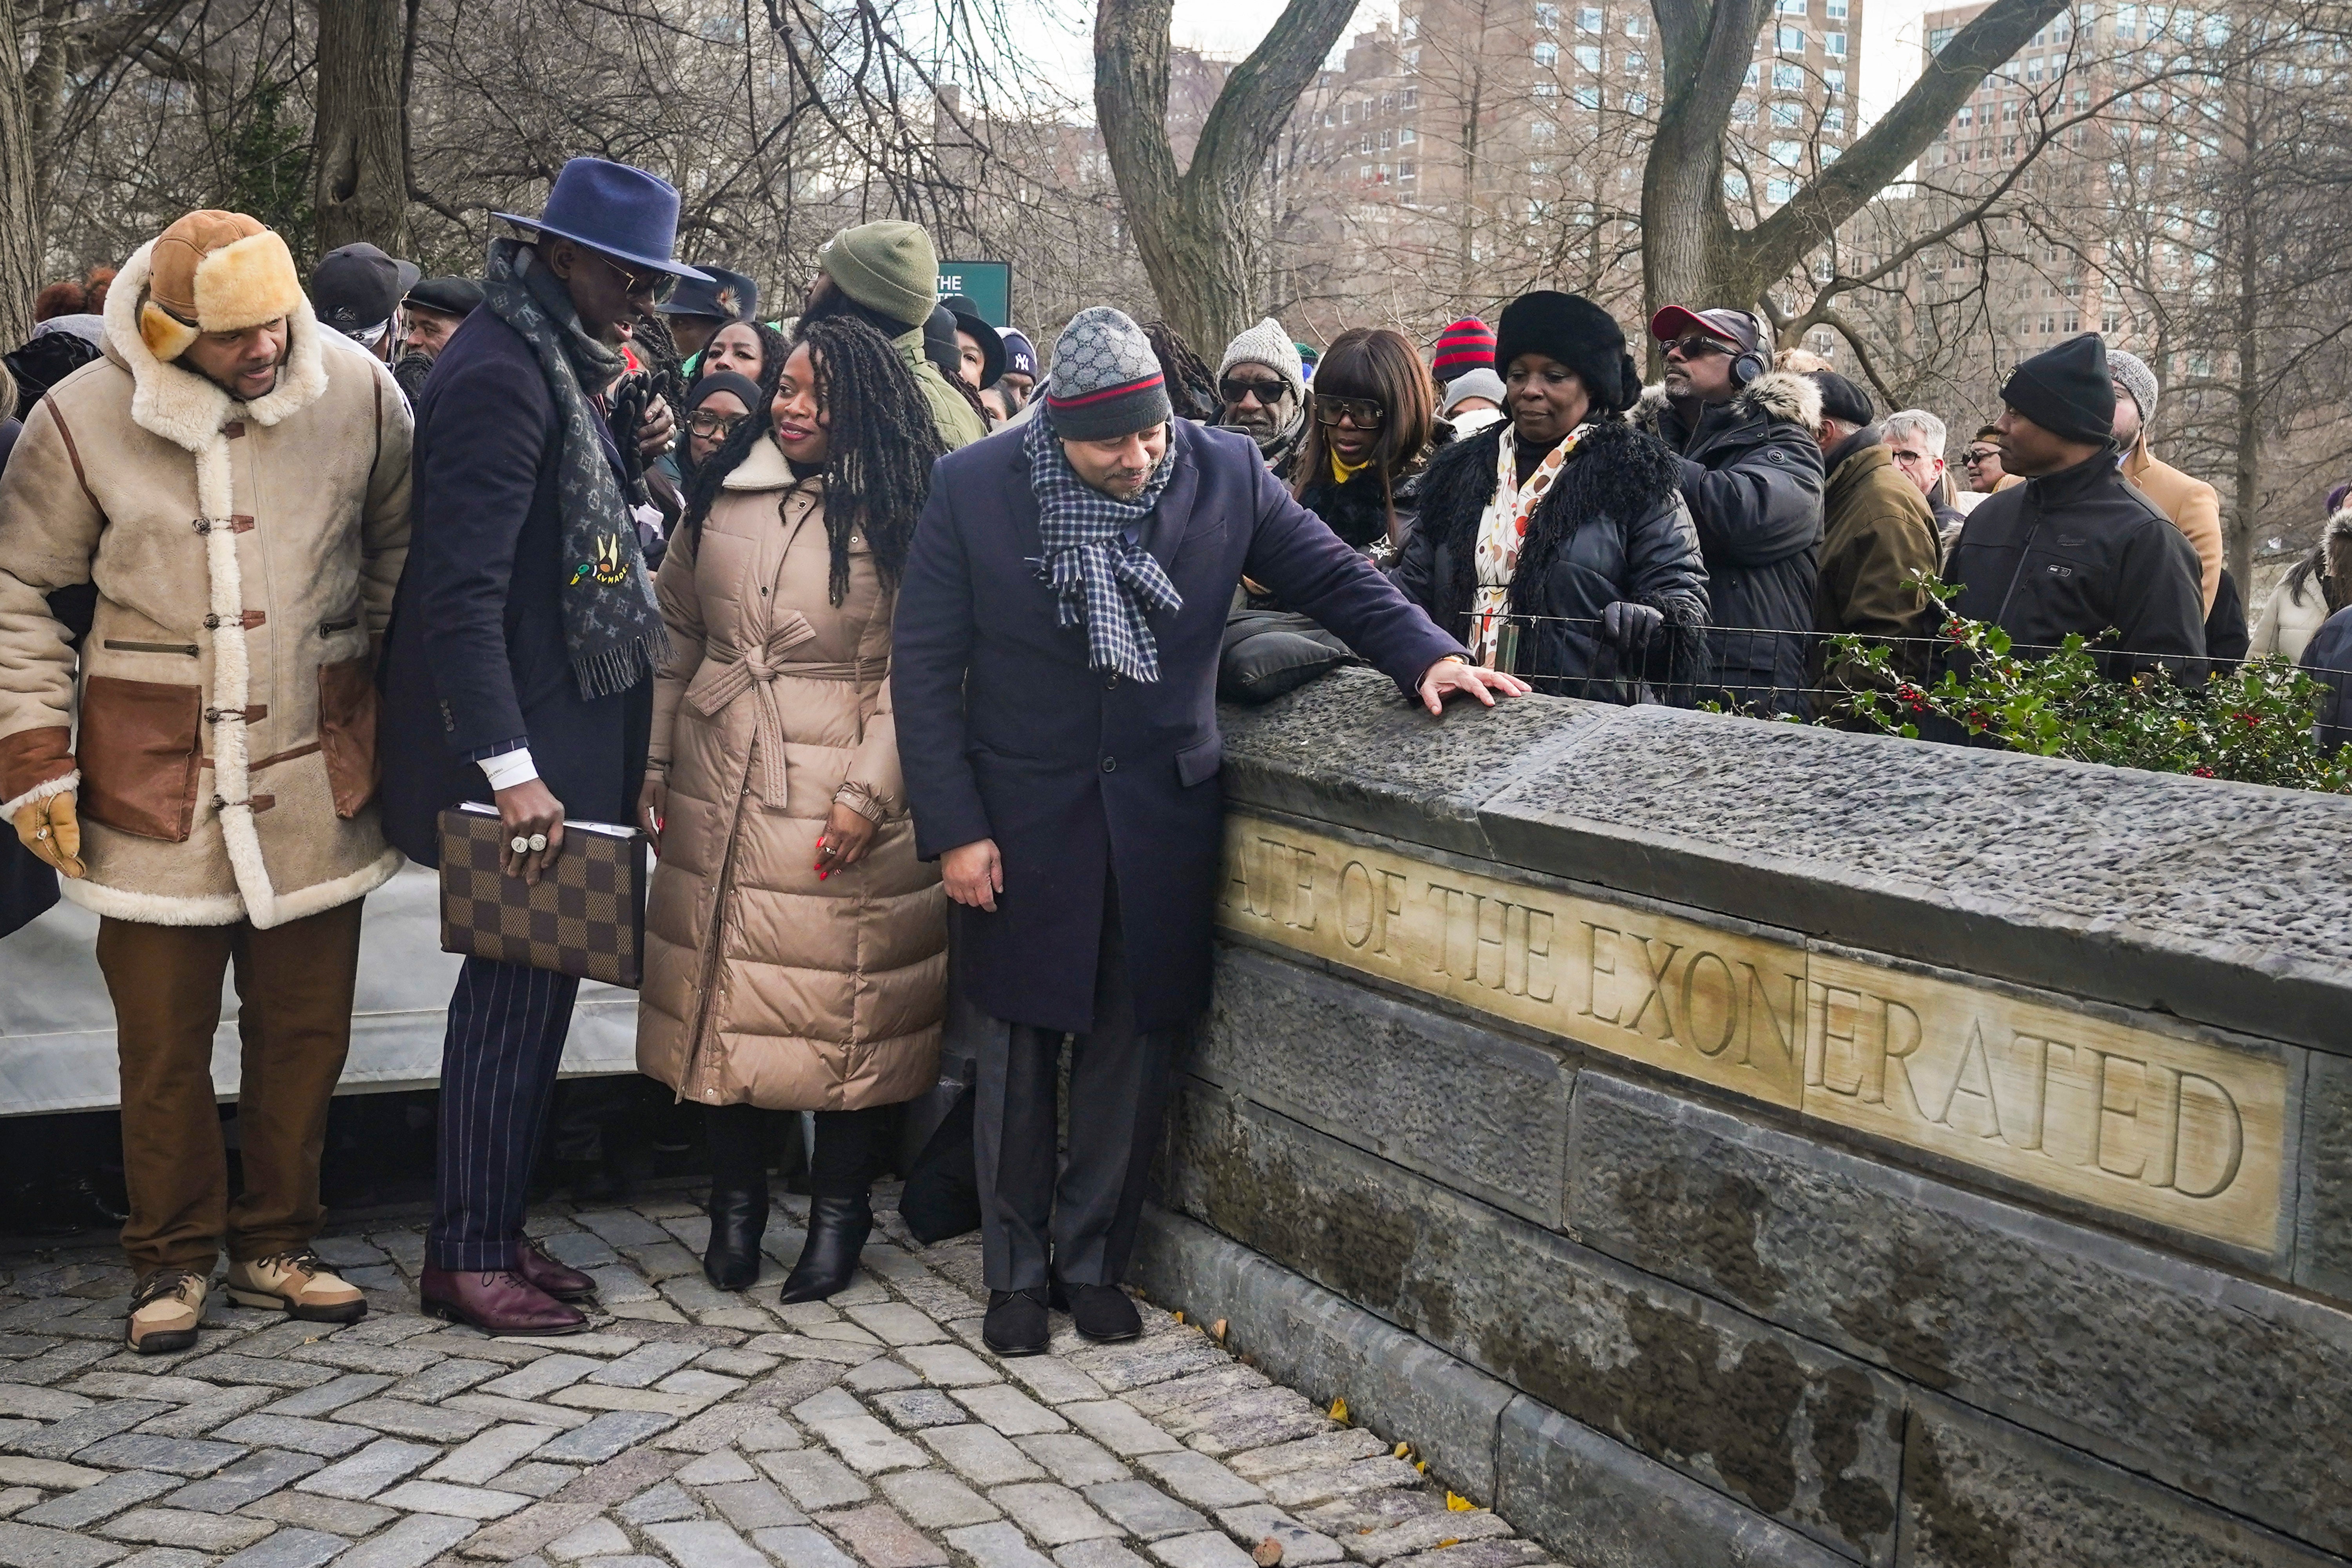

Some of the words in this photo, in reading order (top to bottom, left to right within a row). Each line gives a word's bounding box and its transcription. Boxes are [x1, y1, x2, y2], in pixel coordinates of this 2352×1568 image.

[1015, 353, 1030, 371] NY
[596, 566, 627, 584] LVMADE
[1337, 860, 1407, 958] OF
[1428, 883, 1556, 1003] THE
[1578, 920, 2243, 1199] EXONERATED
